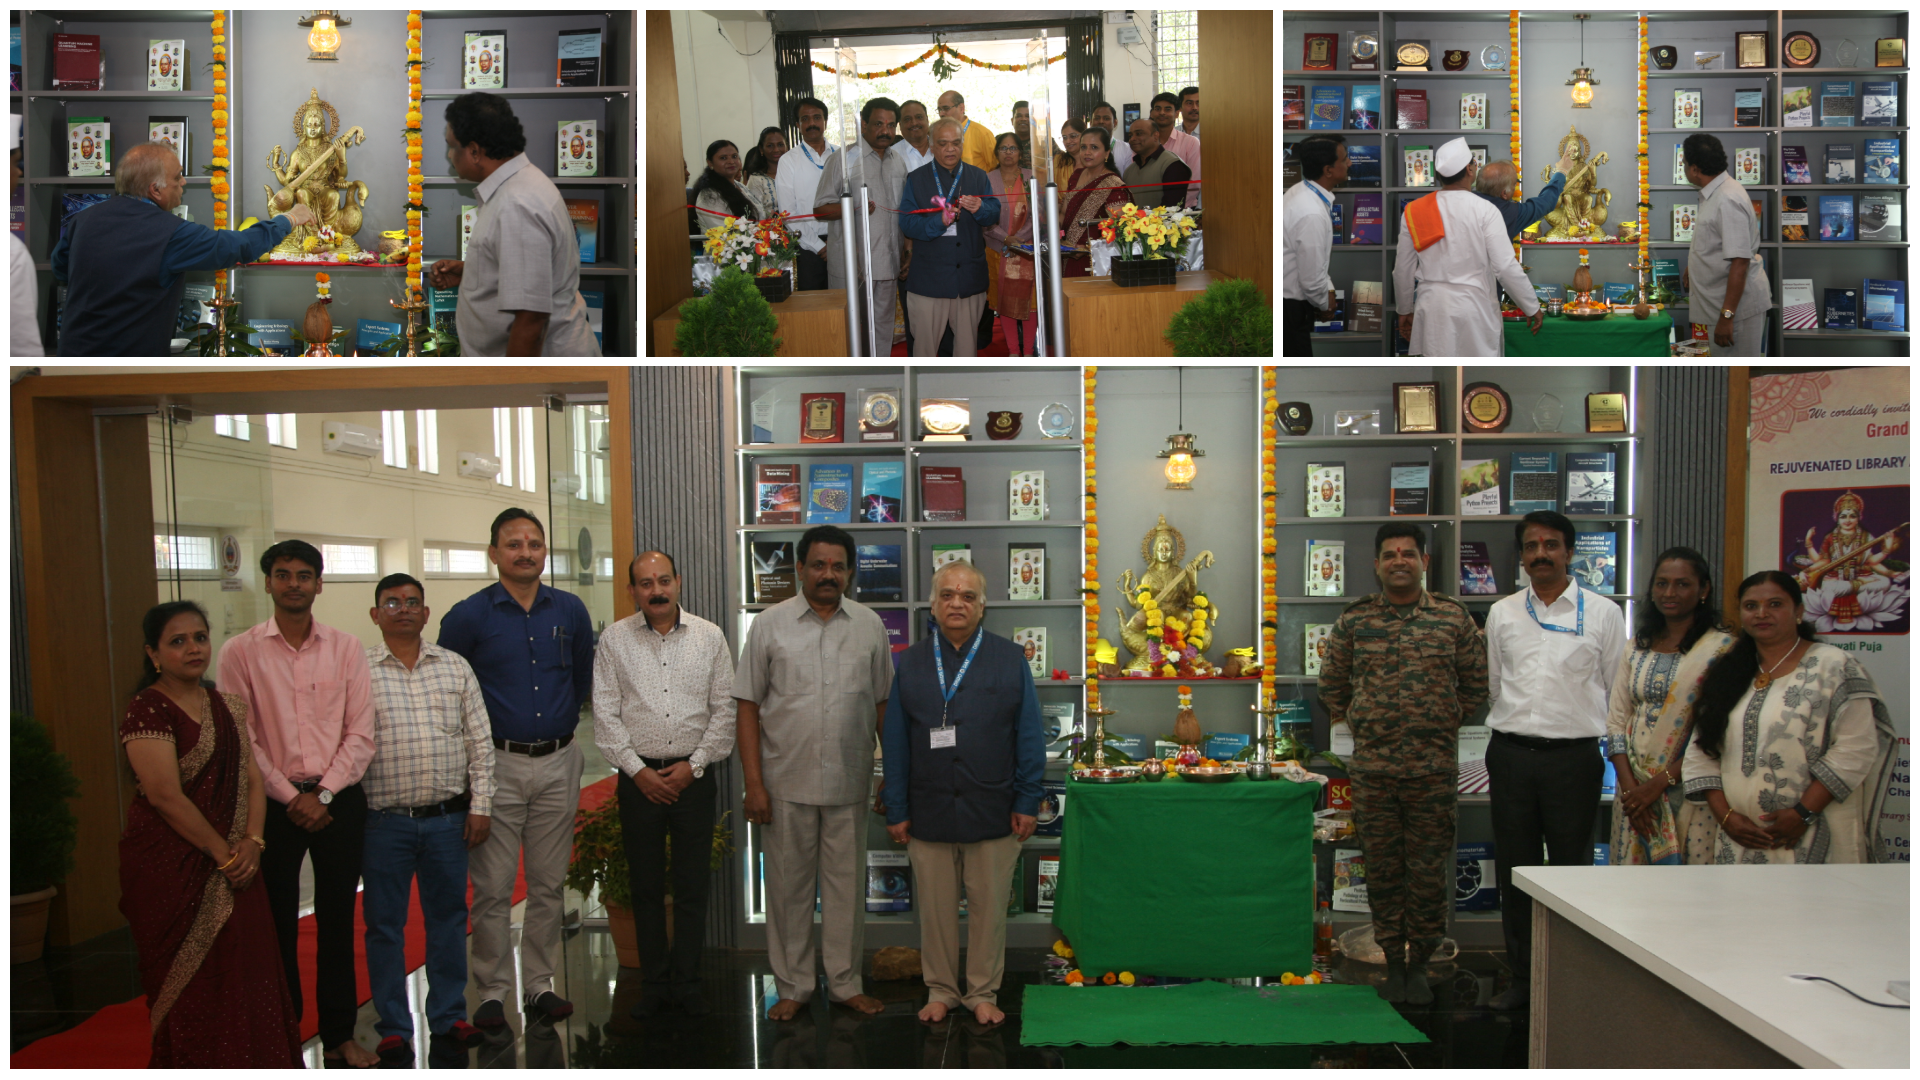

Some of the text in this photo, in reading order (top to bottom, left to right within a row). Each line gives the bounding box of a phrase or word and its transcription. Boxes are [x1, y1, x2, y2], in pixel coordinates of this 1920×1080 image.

[1808, 407, 1826, 419] We
[1830, 403, 1878, 418] cordially
[1866, 421, 1909, 438] Grand
[1770, 456, 1907, 474] REJUVENATED LIBRARY
[1859, 641, 1882, 653] Puja
